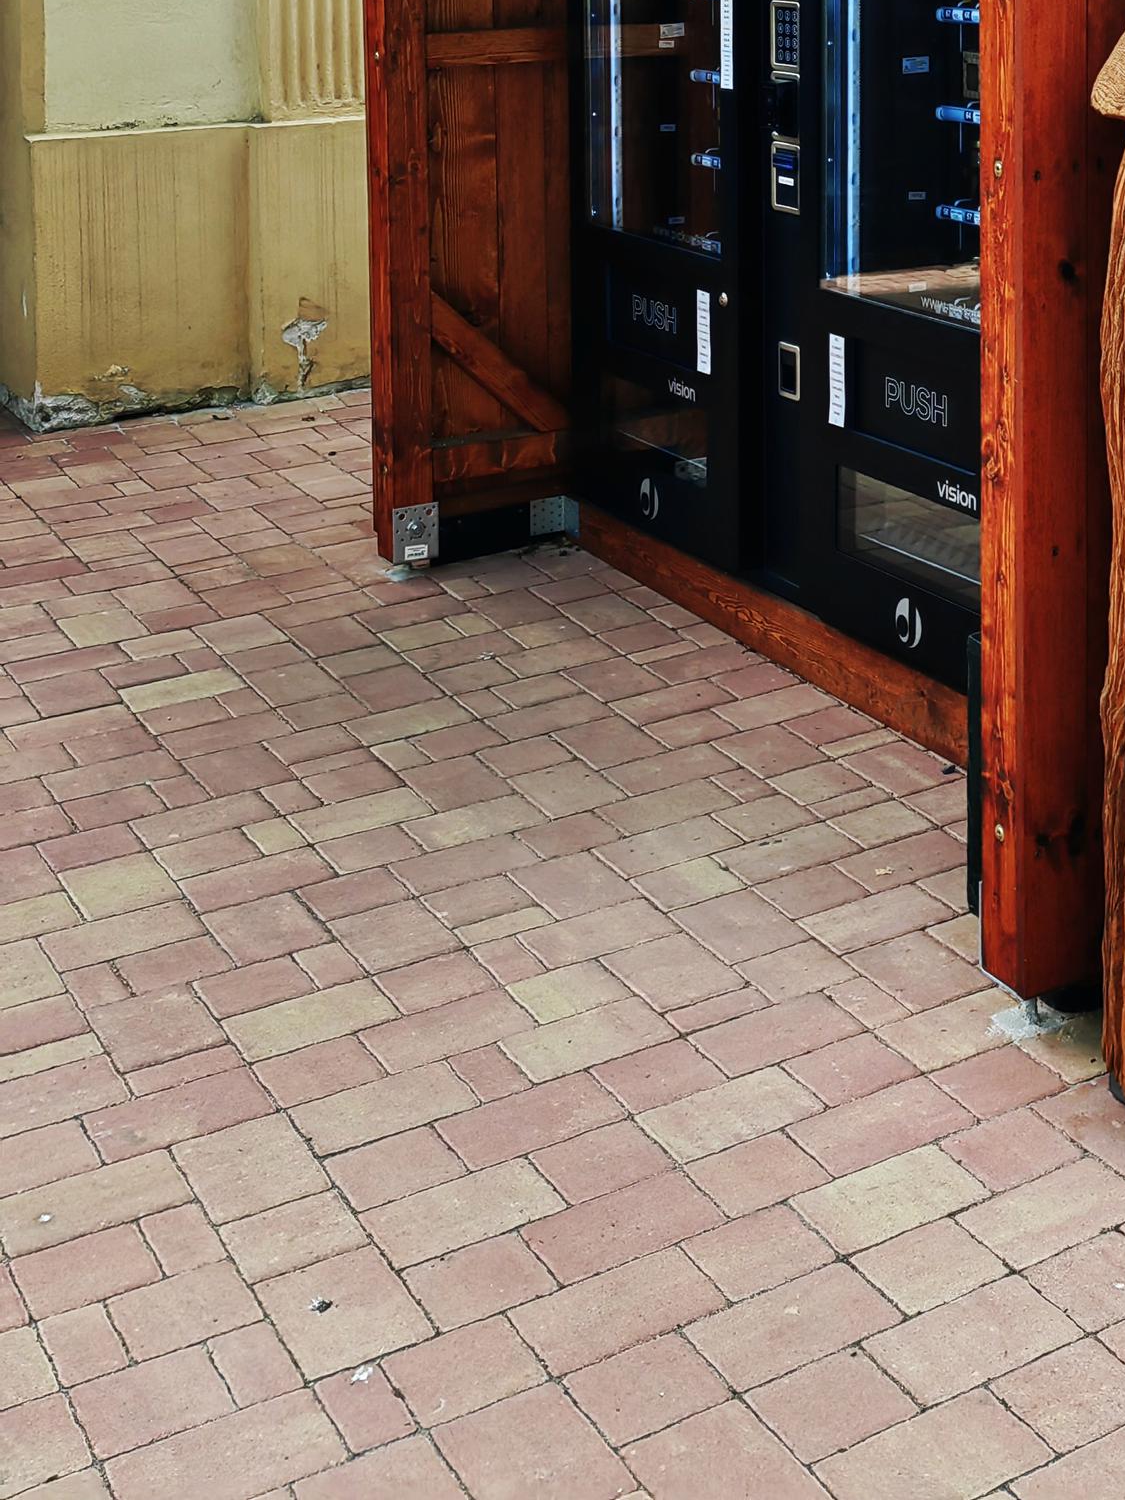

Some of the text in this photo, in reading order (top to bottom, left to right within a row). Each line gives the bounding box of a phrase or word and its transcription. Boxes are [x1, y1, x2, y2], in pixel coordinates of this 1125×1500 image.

[632, 293, 677, 335] PUSH
[668, 376, 696, 402] vision
[885, 376, 948, 427] PUSH
[937, 480, 977, 511] vision
